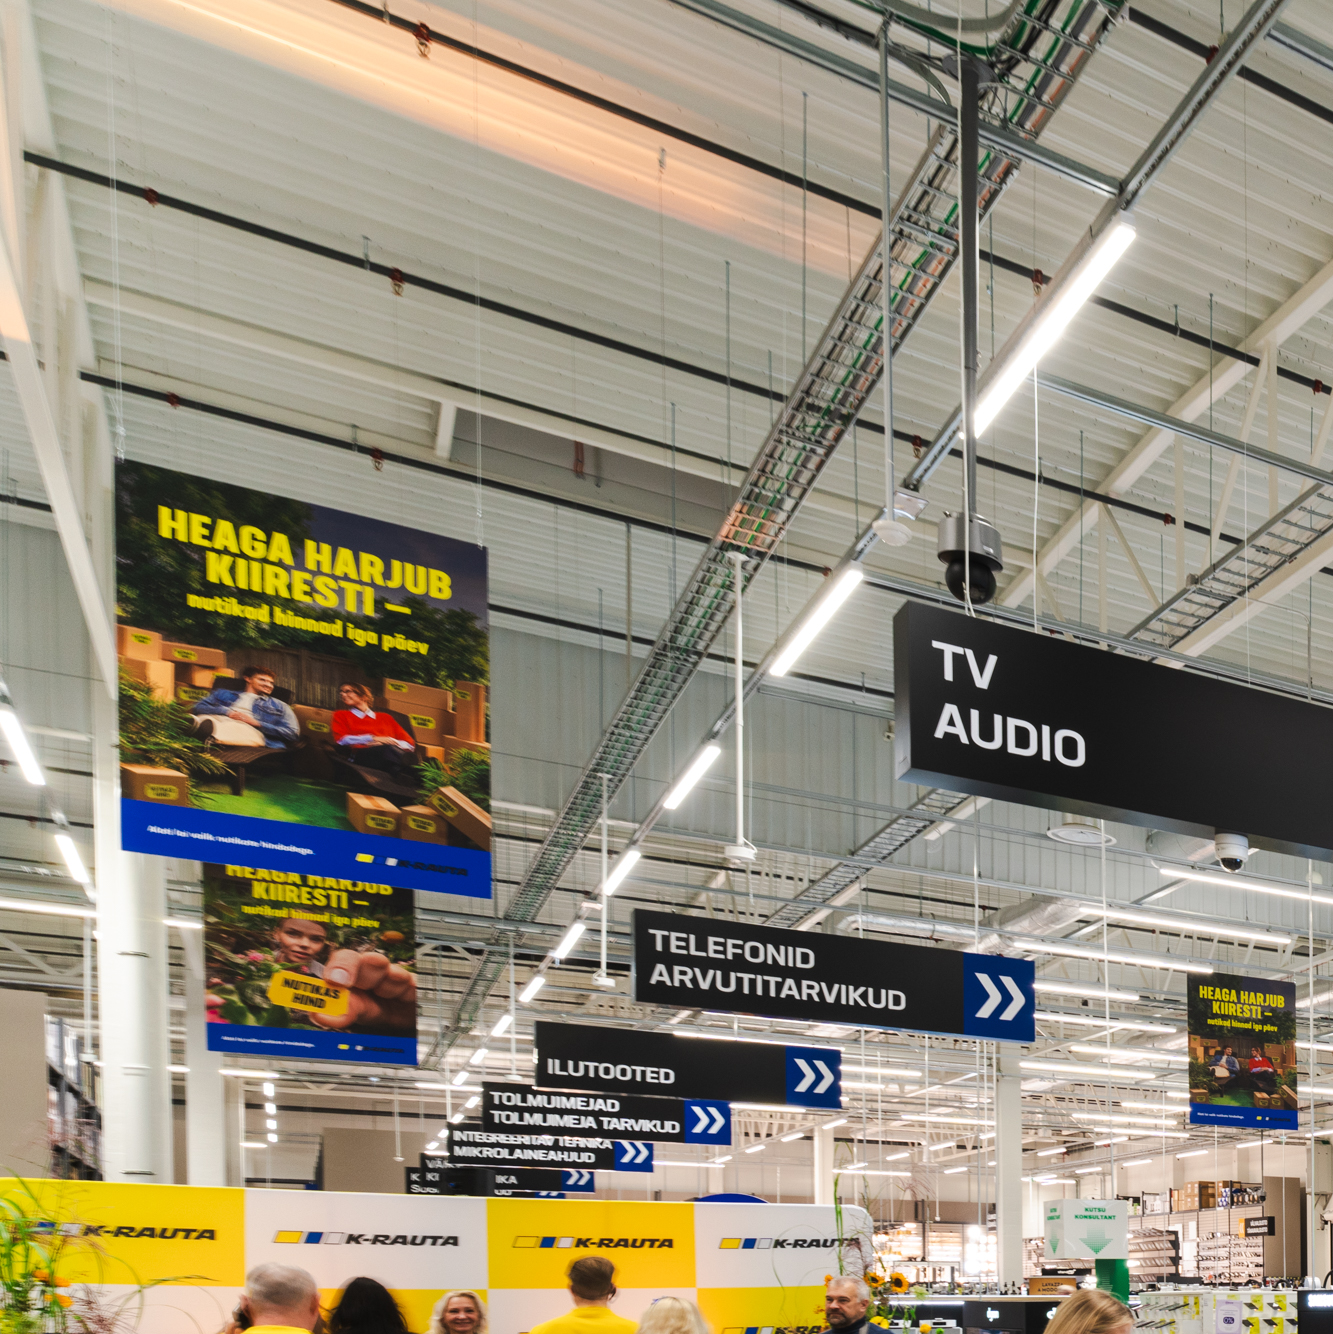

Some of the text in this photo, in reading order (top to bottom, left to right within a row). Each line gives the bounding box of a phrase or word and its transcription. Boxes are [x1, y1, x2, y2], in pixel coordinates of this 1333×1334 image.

[157, 505, 452, 600] HEAGA HARJUB
[205, 551, 375, 617] KIIRESTI
[187, 593, 429, 655] nutikad hinnad iga päev
[931, 640, 998, 690] TV
[933, 704, 1086, 768] AUDIO
[252, 881, 348, 909] KIIRESTI
[648, 928, 815, 969] TELEFONID
[283, 977, 340, 999] NUTIKAS
[649, 964, 906, 1010] ARVUTITARVIKUD
[1199, 985, 1285, 1008] HEAGA HARJUB
[292, 993, 326, 1008] HIND
[1212, 1001, 1261, 1019] KIIRESTI
[1207, 1018, 1278, 1032] nutikad hinnad iga päev
[546, 1057, 675, 1085] ILUTOOTED
[489, 1091, 620, 1112] TOLMUIMEJAD
[489, 1110, 685, 1135] TOLMUIMEJA TARVIKUD
[453, 1146, 595, 1163] MIKROLAINEAHJUD
[82, 1225, 216, 1241] K-RAUTA
[346, 1233, 459, 1246] K-RAUTA
[574, 1238, 674, 1248] K-RAUTA
